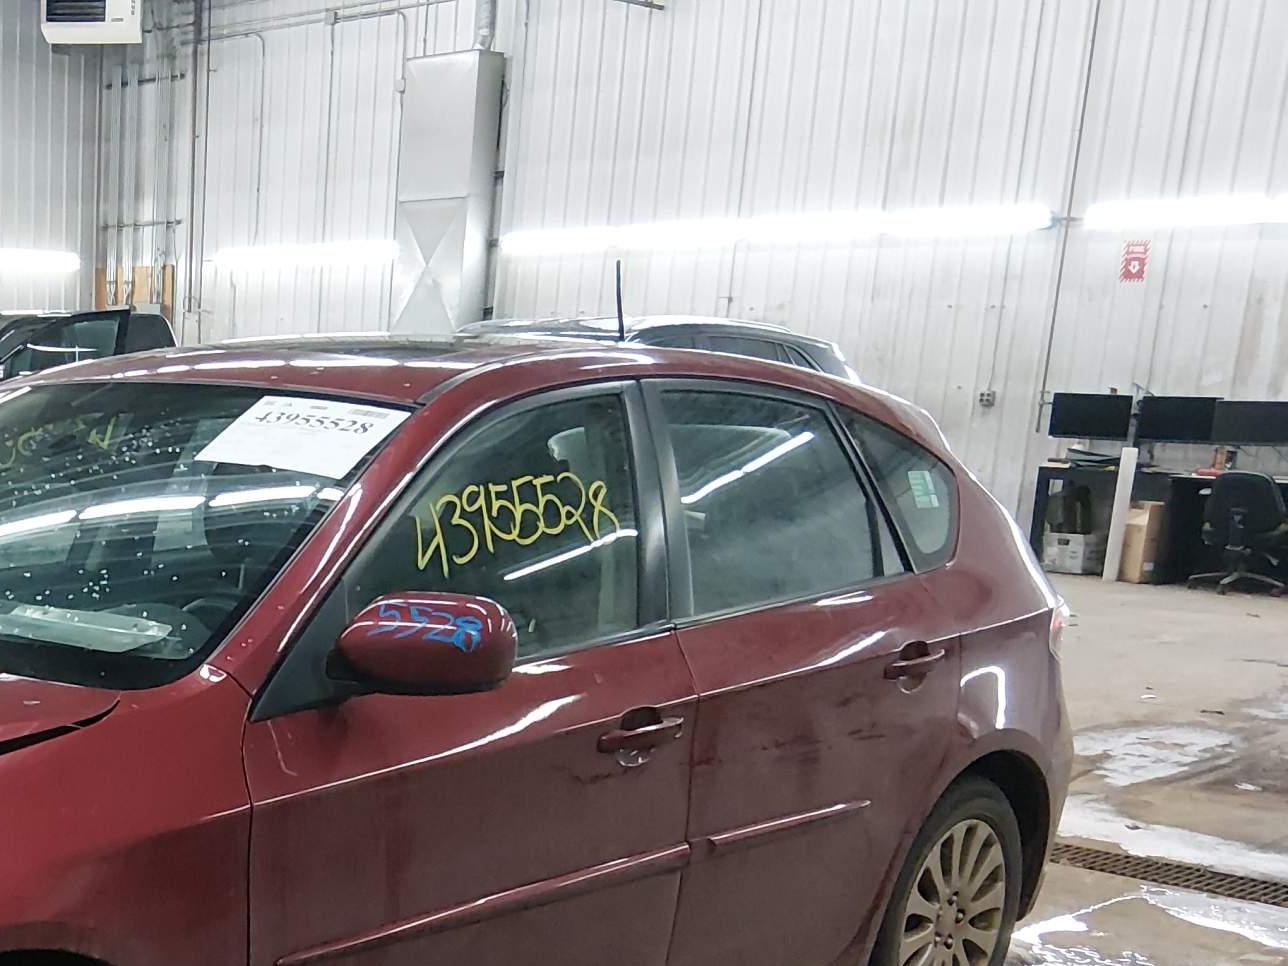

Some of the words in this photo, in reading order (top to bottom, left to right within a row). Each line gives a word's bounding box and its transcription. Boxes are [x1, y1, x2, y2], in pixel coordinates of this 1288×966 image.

[255, 411, 374, 434] 43955528
[415, 472, 620, 578] 43955528
[367, 602, 483, 653] 5528
